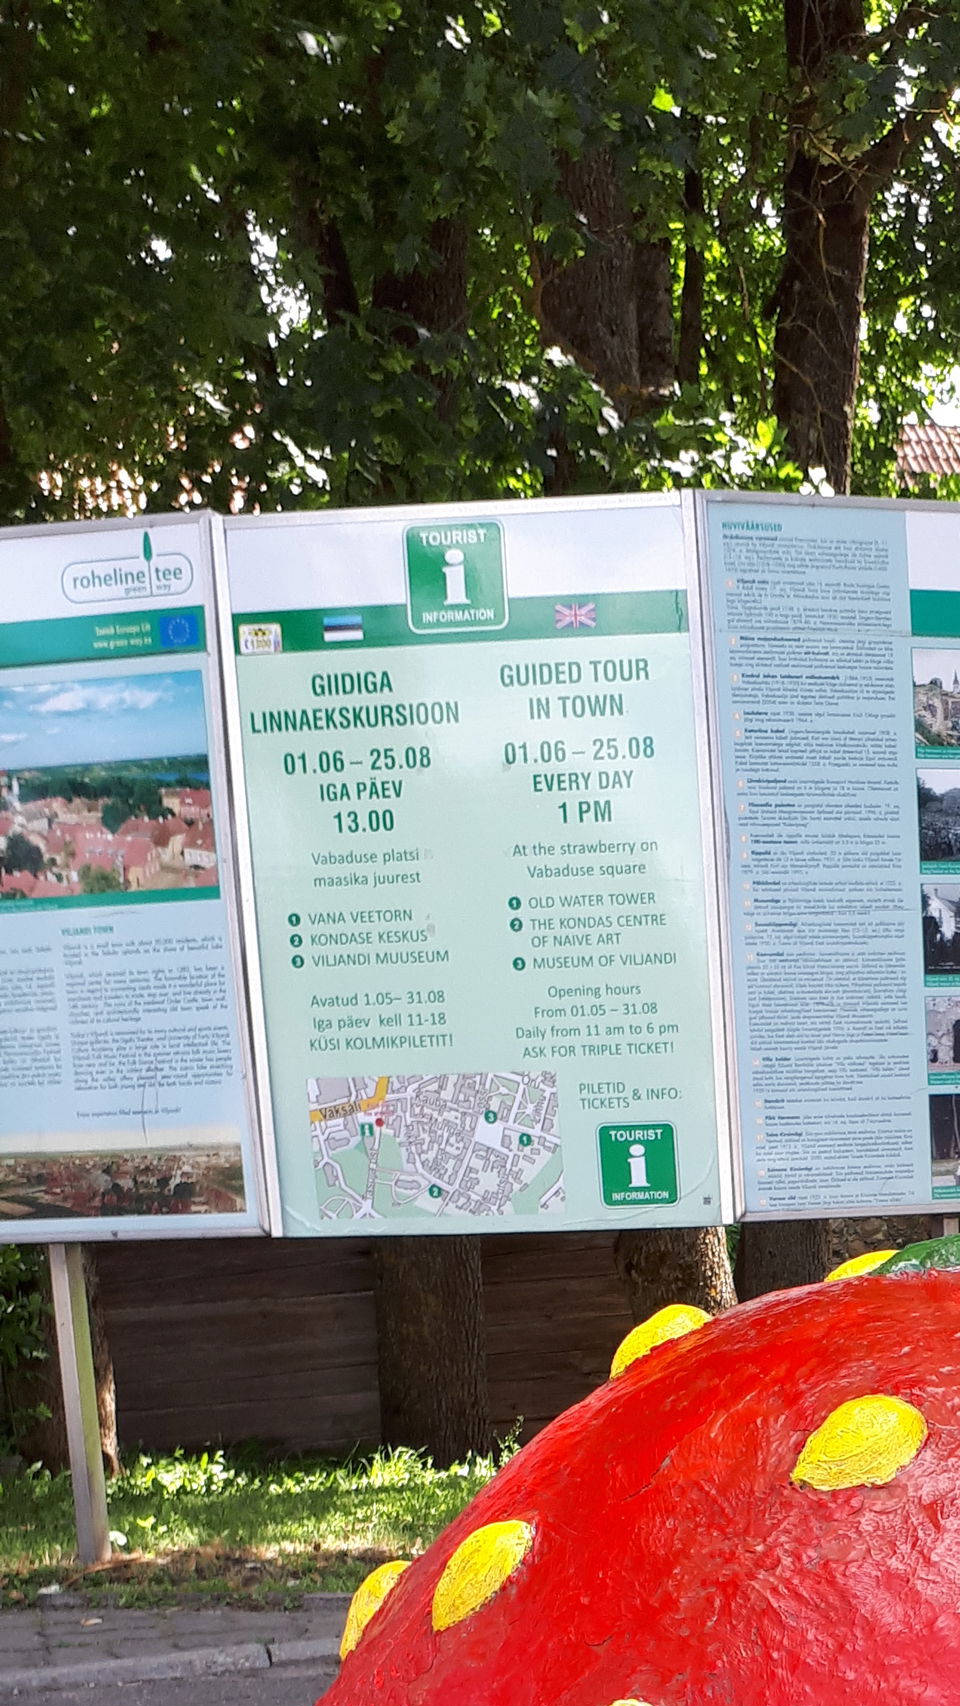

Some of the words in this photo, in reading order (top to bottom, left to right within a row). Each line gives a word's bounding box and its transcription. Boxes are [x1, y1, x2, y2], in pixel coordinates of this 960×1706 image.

[420, 528, 486, 546] TOURIST
[72, 569, 146, 590] roheline
[154, 566, 183, 582] tee
[124, 585, 147, 596] green
[156, 583, 172, 592] way
[422, 608, 494, 624] INFORMATION
[500, 660, 582, 688] GUIDED
[589, 658, 650, 682] TOUR
[311, 670, 394, 697] GIIDIGA
[529, 696, 551, 720] IN
[558, 693, 624, 718] TOWN
[250, 700, 460, 734] LINNAEKSKURSIOON
[504, 740, 566, 765] 01.06
[592, 736, 655, 761] 25.08
[283, 750, 344, 775] 01.06
[370, 746, 432, 770] 25.08
[319, 783, 350, 802] IGA
[357, 777, 403, 800] PÄEV
[532, 772, 591, 793] EVERY
[599, 770, 634, 790] DAY
[333, 808, 394, 834] 13.00
[558, 801, 568, 824] 1
[578, 800, 612, 824] PM
[312, 850, 378, 866] Vabaduse
[382, 848, 420, 865] platsi
[512, 844, 528, 857] At
[532, 842, 555, 856] the
[560, 840, 636, 855] strawberry
[640, 840, 658, 852] on
[527, 863, 594, 878] Vabaduse
[600, 862, 646, 876] square
[314, 872, 369, 888] maasika
[373, 872, 421, 888] juurest
[528, 896, 555, 910] OLD
[560, 894, 604, 908] WATER
[608, 892, 656, 906] TOWER
[308, 912, 346, 925] VANA
[350, 909, 414, 924] VEETORN
[530, 918, 554, 931] THE
[560, 916, 612, 930] KONDAS
[616, 914, 666, 928] CENTRE
[310, 932, 373, 946] KONDASE
[378, 929, 428, 944] KESKUS
[531, 934, 548, 948] OF
[553, 934, 592, 947] NAIVE
[596, 932, 622, 946] ART
[312, 953, 371, 968] VILJANDI
[375, 950, 450, 965] MUUSEUM
[532, 956, 594, 970] MUSEUM
[598, 954, 615, 967] OF
[620, 952, 677, 966] VILJANDI
[311, 994, 358, 1008] Avatud
[406, 990, 446, 1005] 31.08
[548, 985, 602, 1000] Opening
[605, 982, 641, 996] hours
[534, 1006, 566, 1018] From
[570, 1004, 606, 1017] 01.05
[622, 1002, 658, 1015] 31.08
[313, 1017, 332, 1032] Iga
[338, 1015, 370, 1031] päev
[379, 1014, 402, 1027] kell
[407, 1012, 446, 1026] 11-18
[515, 1026, 546, 1041] Daily
[551, 1024, 581, 1037] from
[586, 1024, 600, 1036] 11
[605, 1026, 624, 1036] am
[628, 1023, 642, 1035] to
[646, 1022, 654, 1034] 6
[659, 1024, 680, 1037] pm
[310, 1036, 340, 1052] KÜSI
[346, 1034, 454, 1050] KOLMIKPILETIT!
[522, 1046, 547, 1059] ASK
[551, 1045, 576, 1058] FOR
[582, 1044, 622, 1056] TRIPLE
[626, 1041, 674, 1054] TICKET!
[579, 1082, 626, 1095] PILETID
[632, 1088, 642, 1100] &
[646, 1088, 683, 1100] INFO:
[319, 1101, 362, 1120] Vaksali
[579, 1096, 630, 1110] TICKETS
[609, 1129, 663, 1142] TOURIST
[612, 1191, 669, 1201] INFORMATION
